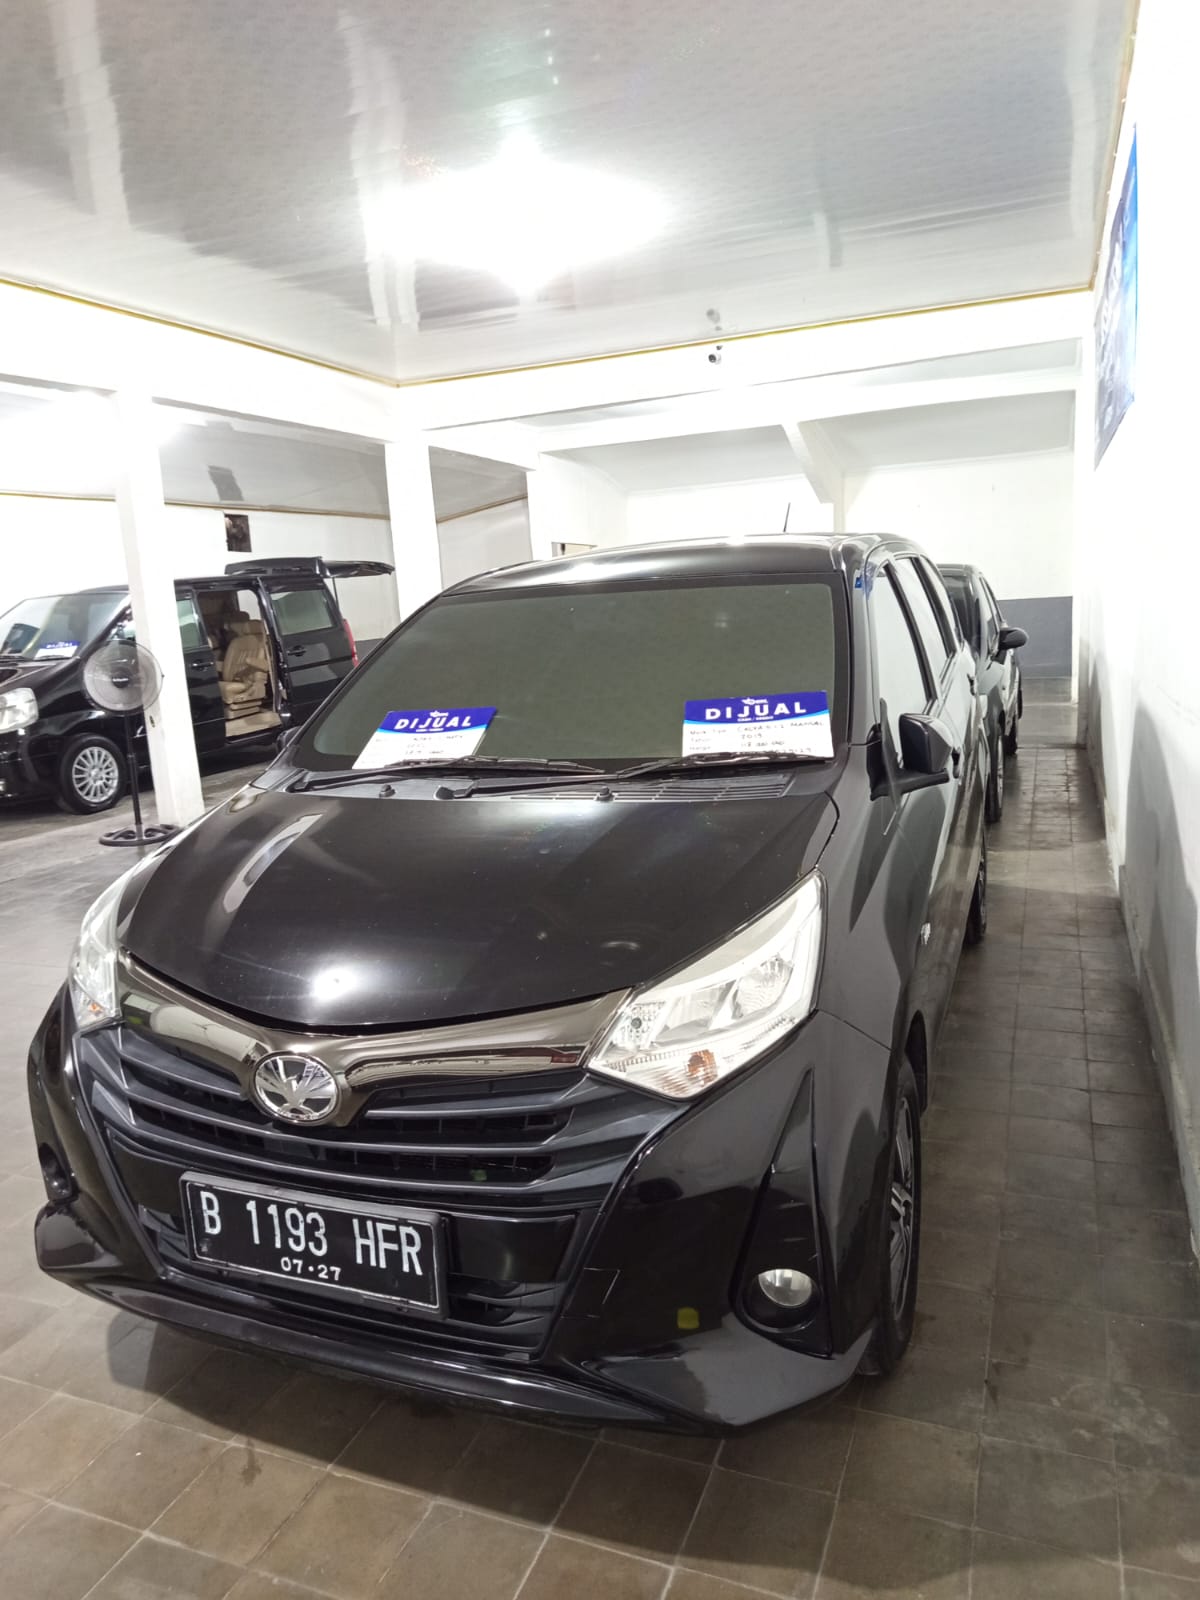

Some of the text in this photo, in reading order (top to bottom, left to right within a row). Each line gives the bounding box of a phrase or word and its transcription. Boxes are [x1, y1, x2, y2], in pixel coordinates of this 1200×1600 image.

[704, 701, 807, 721] DIJUAL
[394, 715, 472, 730] DIJUAL
[200, 1191, 423, 1276] B 1193 HFR
